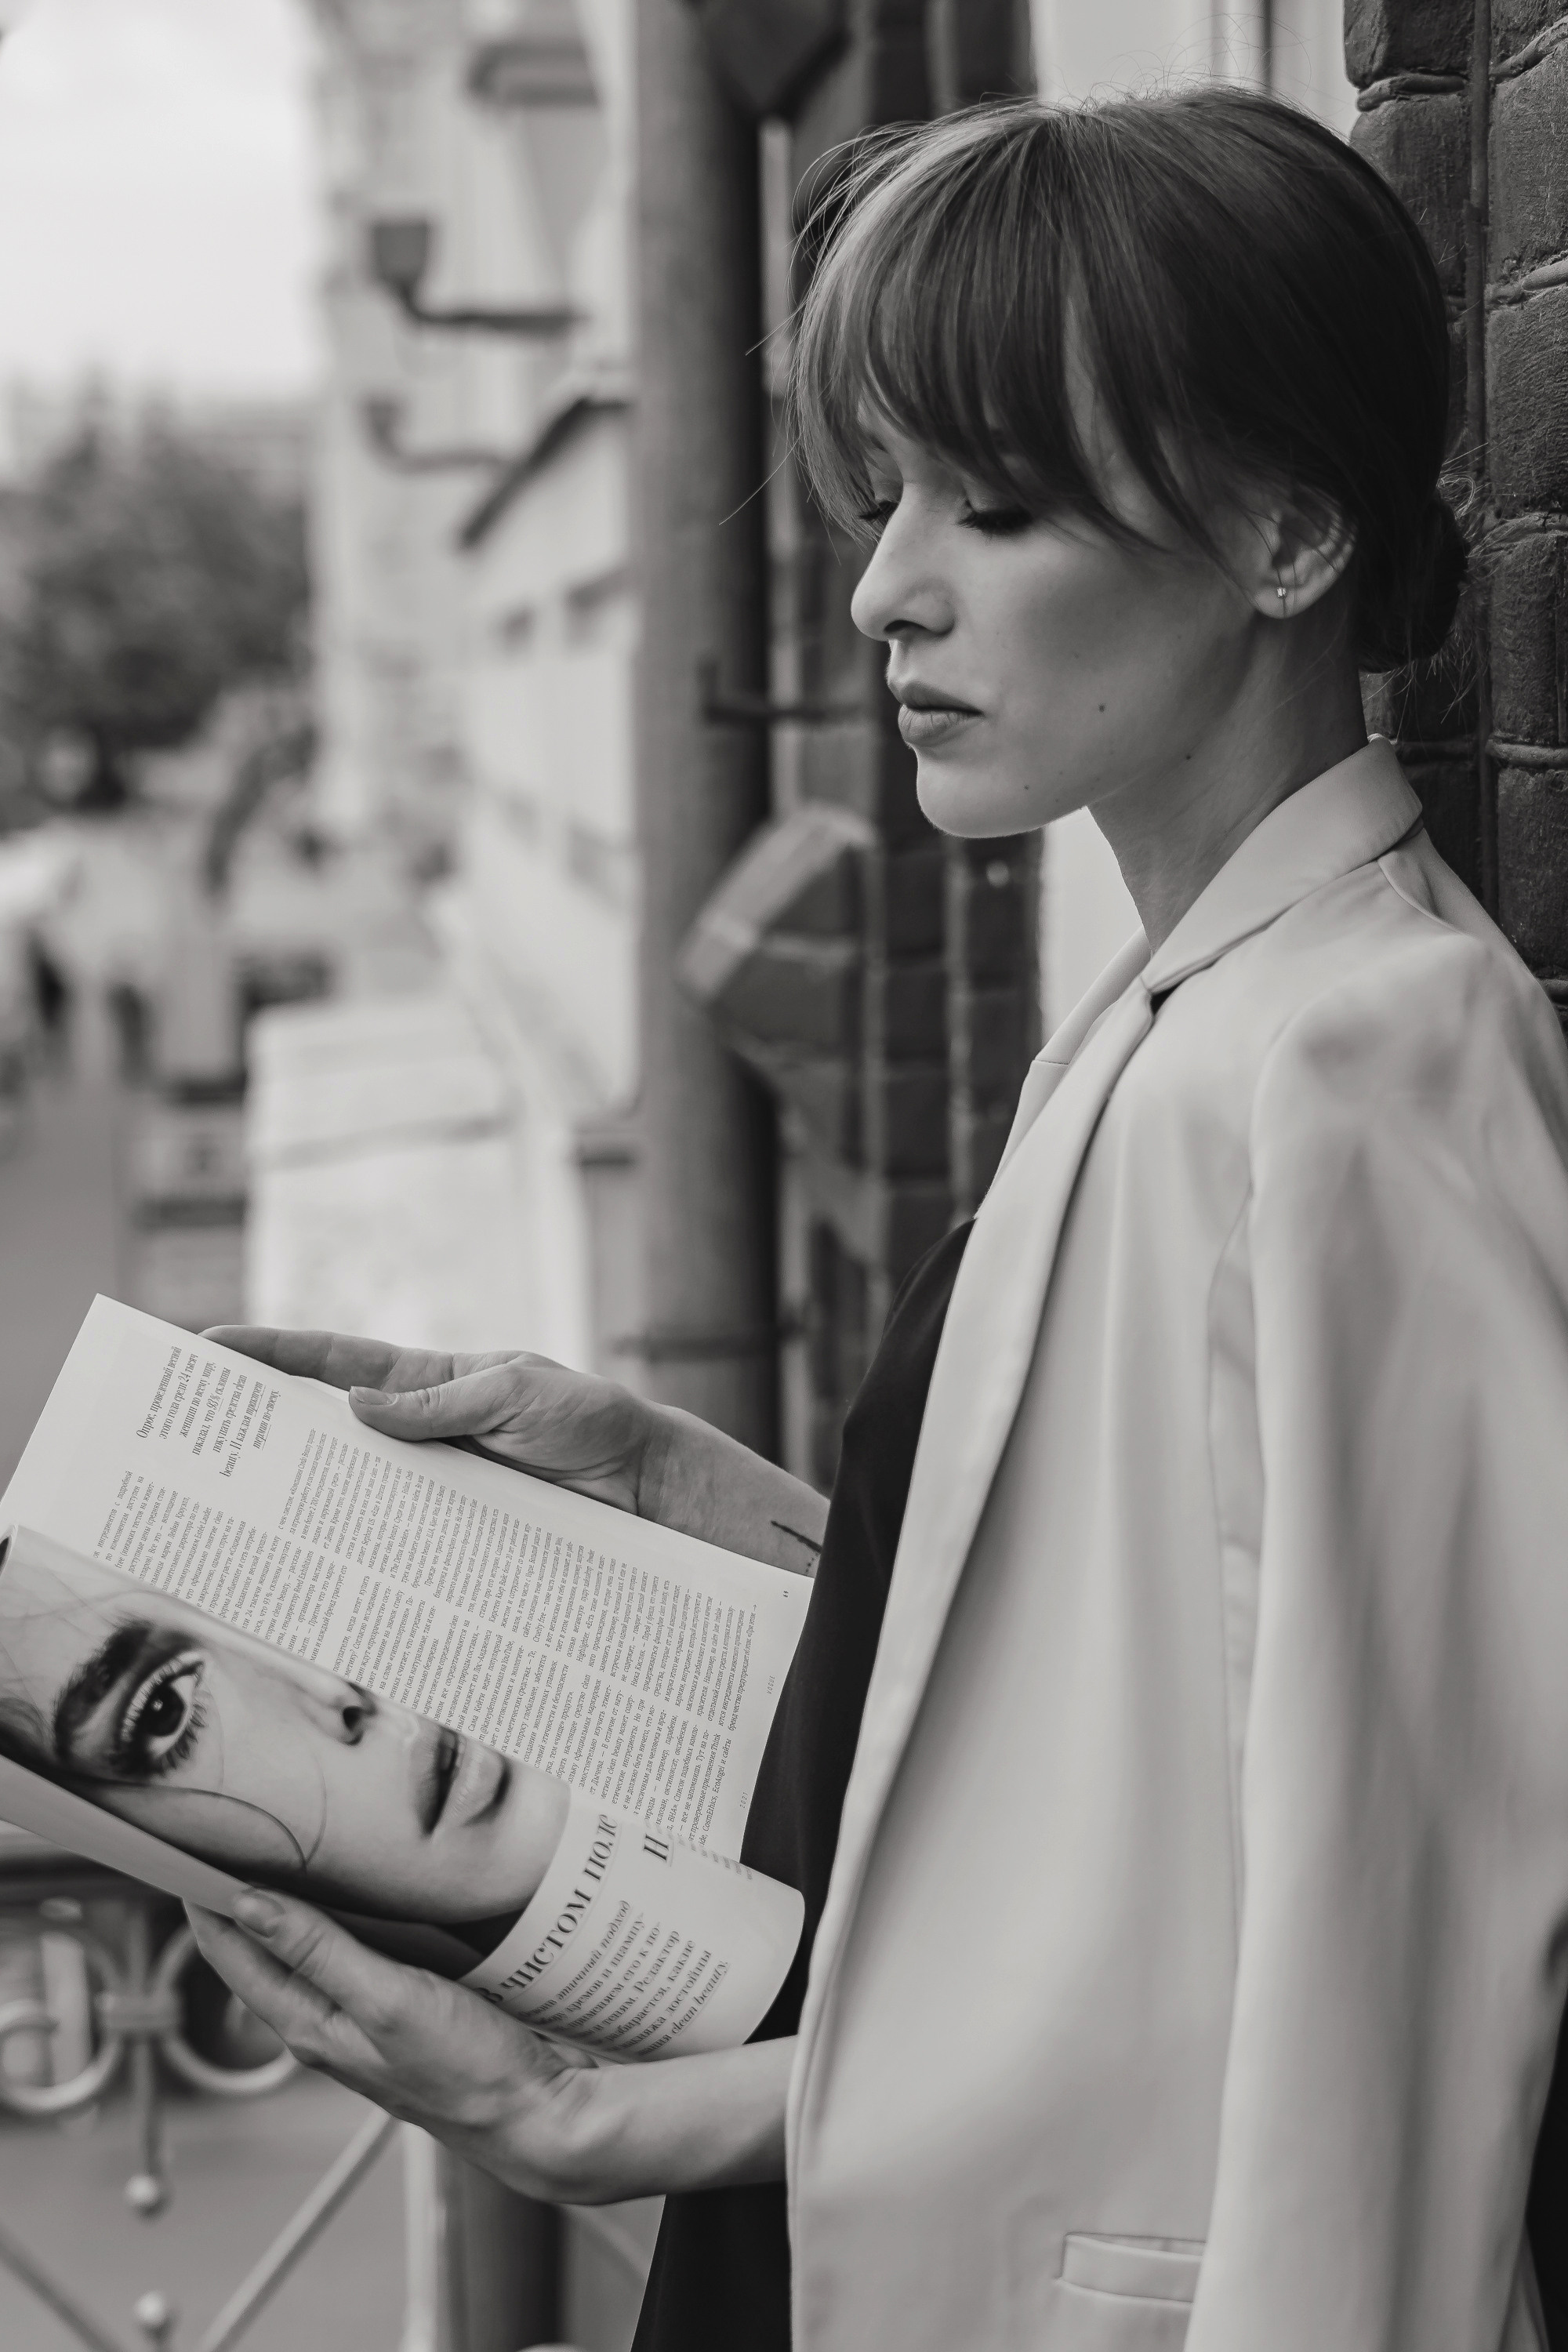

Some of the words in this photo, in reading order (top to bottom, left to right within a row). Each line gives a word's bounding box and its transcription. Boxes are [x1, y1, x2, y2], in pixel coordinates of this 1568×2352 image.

[177, 1371, 191, 1383] 24
[184, 1353, 199, 1374] тысяч
[136, 1413, 158, 1439] Опрос,
[150, 1367, 174, 1413] проведенный
[167, 1345, 182, 1369] весной
[173, 1381, 188, 1403] среди
[194, 1377, 211, 1398] всему
[215, 1367, 231, 1396] склонны
[232, 1374, 248, 1392] clean
[167, 1402, 180, 1419] года
[191, 1396, 201, 1407] по
[205, 1392, 221, 1410] 93%
[225, 1390, 242, 1419] средства
[158, 1417, 173, 1439] этого
[179, 1406, 198, 1439] женщин
[204, 1410, 216, 1422] что
[235, 1414, 252, 1443] каждая
[191, 1424, 212, 1456] показал,
[212, 1419, 231, 1454] покупать
[229, 1440, 242, 1450] И
[252, 1420, 270, 1450] термин
[140, 1501, 147, 1510] на
[143, 1481, 155, 1502] живот-
[156, 1486, 166, 1502] стои-
[105, 1552, 113, 1562] по
[109, 1512, 130, 1551] компонентам
[125, 1485, 141, 1512] доступен
[136, 1475, 145, 1484] на
[132, 1510, 144, 1530] тестов
[145, 1501, 162, 1526] (средняя
[119, 1529, 136, 1557] (никаких
[140, 1526, 151, 1542] цены
[114, 1556, 125, 1569] free
[128, 1541, 145, 1574] доступные
[185, 1588, 194, 1599] что
[191, 1551, 209, 1587] официально
[205, 1526, 219, 1550] понятие
[212, 1511, 224, 1525] clean
[225, 1567, 242, 1599] Influenster
[239, 1551, 249, 1563] сеть
[244, 1526, 257, 1552] потреби-
[298, 1550, 314, 1581] Exhibitions
[293, 1578, 304, 1594] Reed
[281, 1592, 301, 1632] гендиректор
[332, 1635, 352, 1672] покупатели,
[346, 1615, 357, 1633] когда
[352, 1596, 363, 1615] хотят
[358, 1575, 370, 1596] купить
[448, 1614, 459, 1630] clean
[379, 1681, 387, 1690] на
[383, 1661, 393, 1680] слово
[405, 1595, 414, 1606] По-
[438, 1628, 456, 1666] определение
[434, 1664, 444, 1680] свое
[467, 1715, 479, 1732] Сама
[474, 1692, 486, 1713] Кейти
[481, 1672, 492, 1691] ведет
[488, 1633, 503, 1671] популярный
[766, 1675, 775, 1694] VOGUE
[429, 1679, 439, 1695] тоже
[523, 1731, 537, 1762] создании
[533, 1689, 550, 1730] экологичных
[612, 1769, 626, 1805] етические
[633, 1712, 641, 1722] Но
[637, 1698, 646, 1711] при
[702, 1795, 719, 1832] CosmEthics,
[712, 1765, 726, 1794] EcoAngel
[722, 1737, 732, 1759] сайты
[499, 1888, 593, 1991] ЧИСТОМ
[600, 1899, 631, 1952] подход
[624, 1958, 643, 1984] его
[639, 1948, 650, 1959] к
[665, 1940, 697, 1985] какие
[566, 1979, 605, 2016] кремов
[603, 1968, 613, 1980] и
[593, 2021, 604, 2034] и
[633, 1929, 681, 1994] Редактор
[665, 1949, 713, 2017] достойны
[671, 2004, 699, 2036] clean
